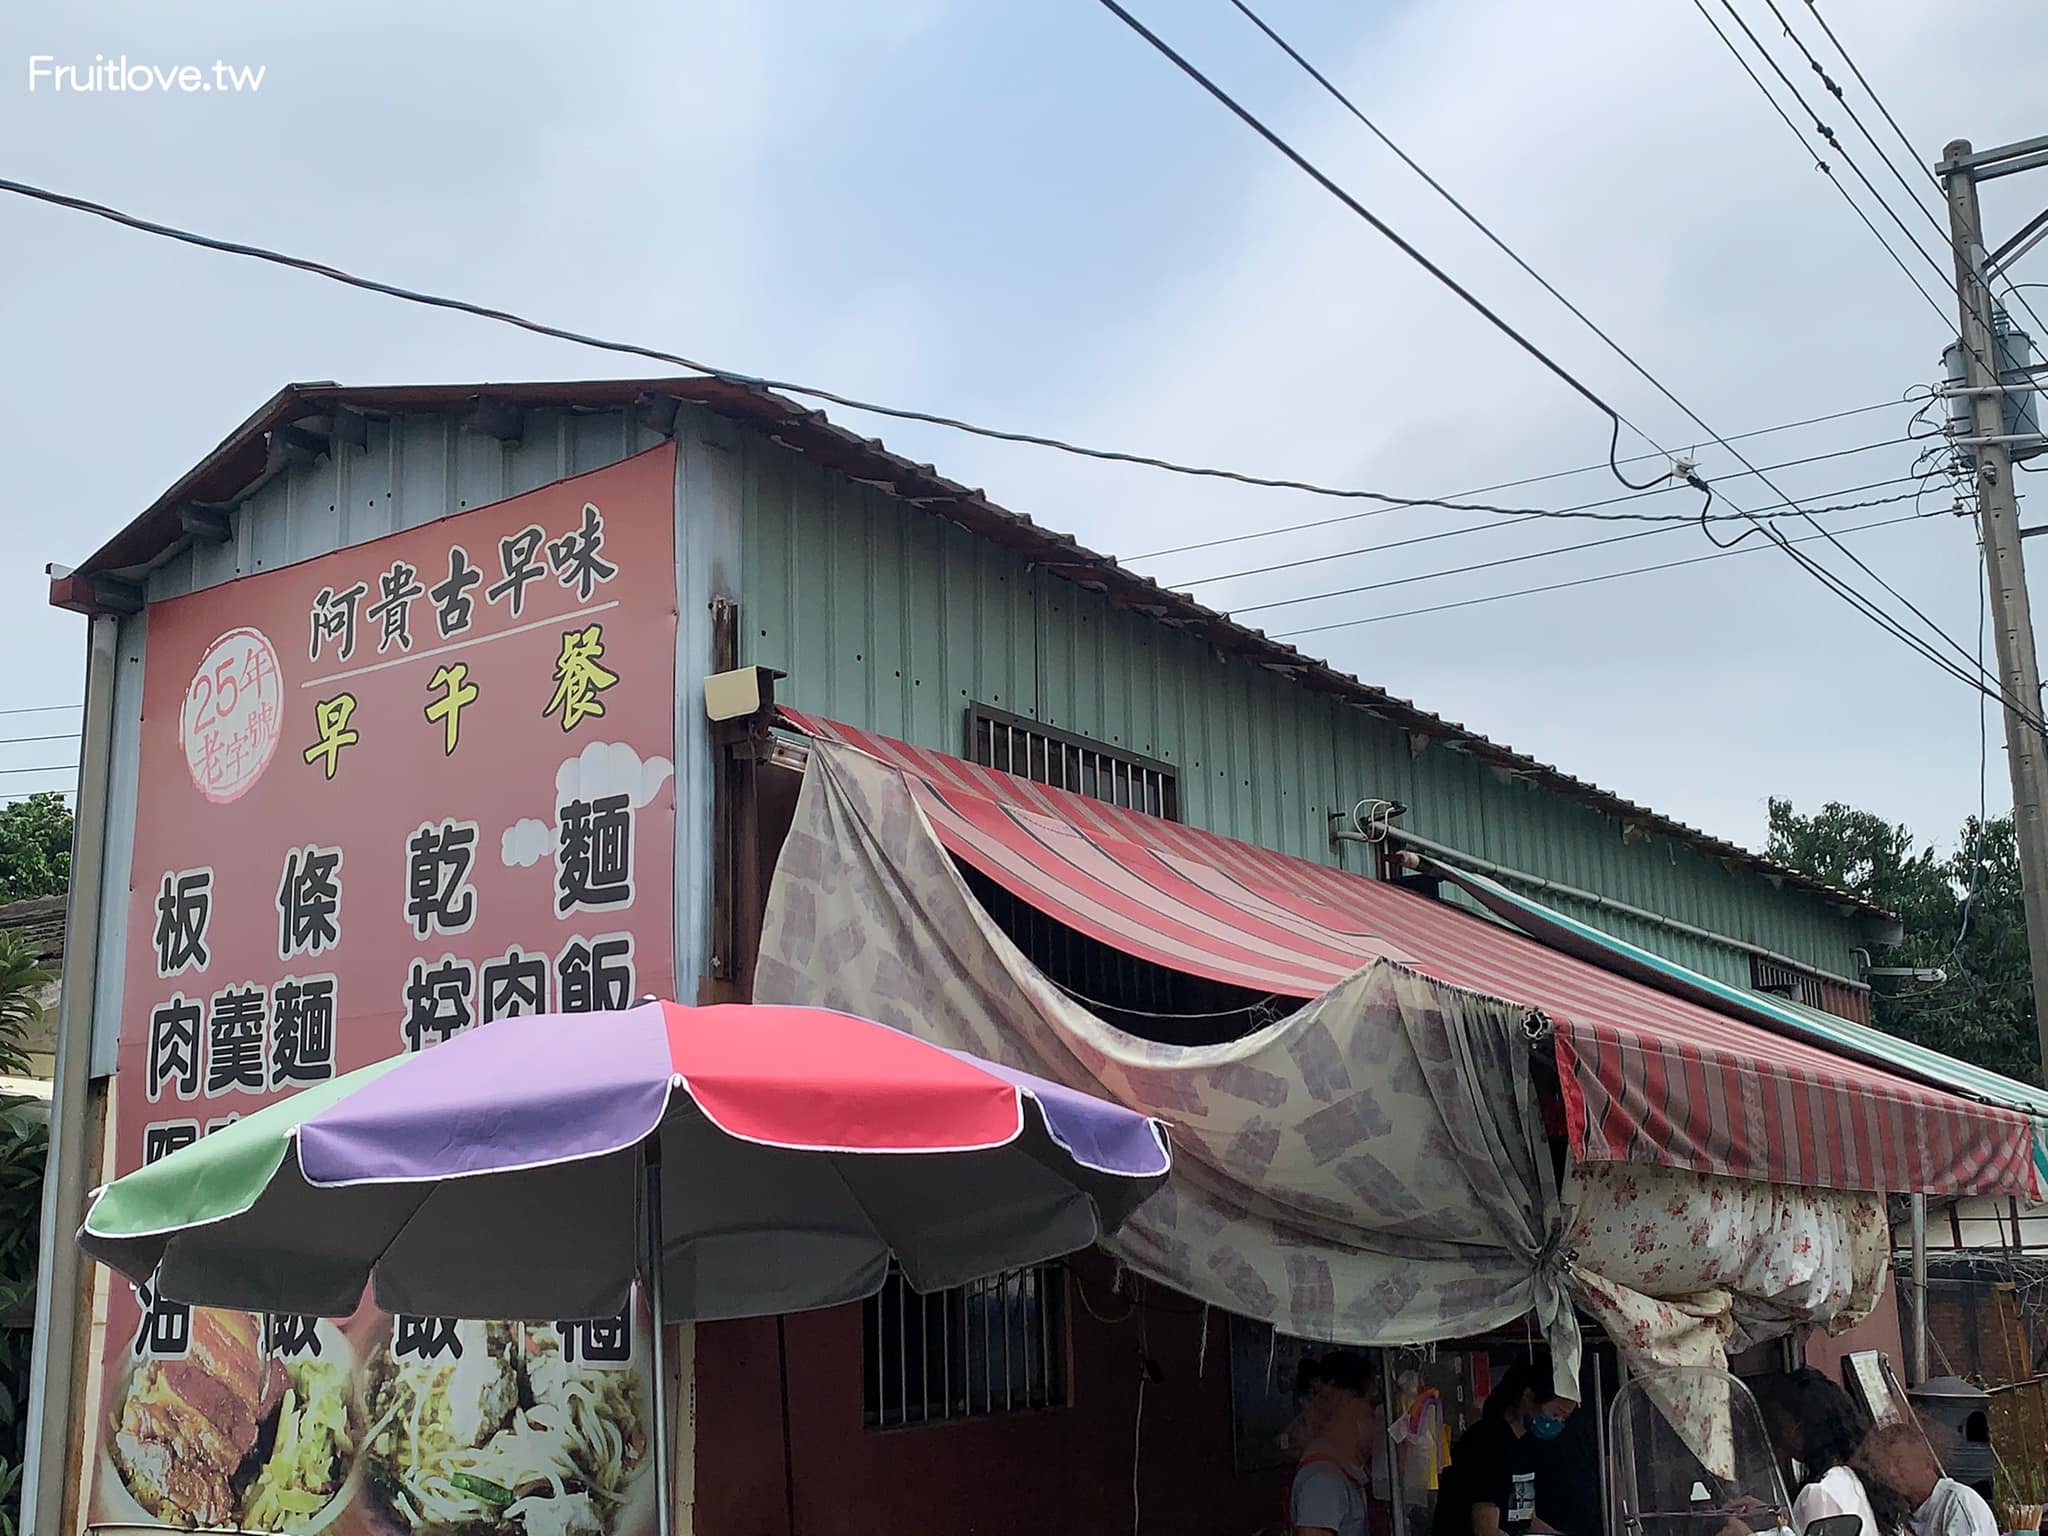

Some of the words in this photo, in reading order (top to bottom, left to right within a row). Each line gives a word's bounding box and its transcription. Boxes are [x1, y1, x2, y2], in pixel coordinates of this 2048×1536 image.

[311, 504, 618, 660] 阿貴古早味
[192, 647, 275, 736] 25年
[193, 702, 280, 785] 老字號
[304, 625, 620, 780] 早午餐
[155, 851, 341, 972] 板條
[406, 793, 632, 935] 乾麵
[149, 978, 335, 1097] 肉羹麵
